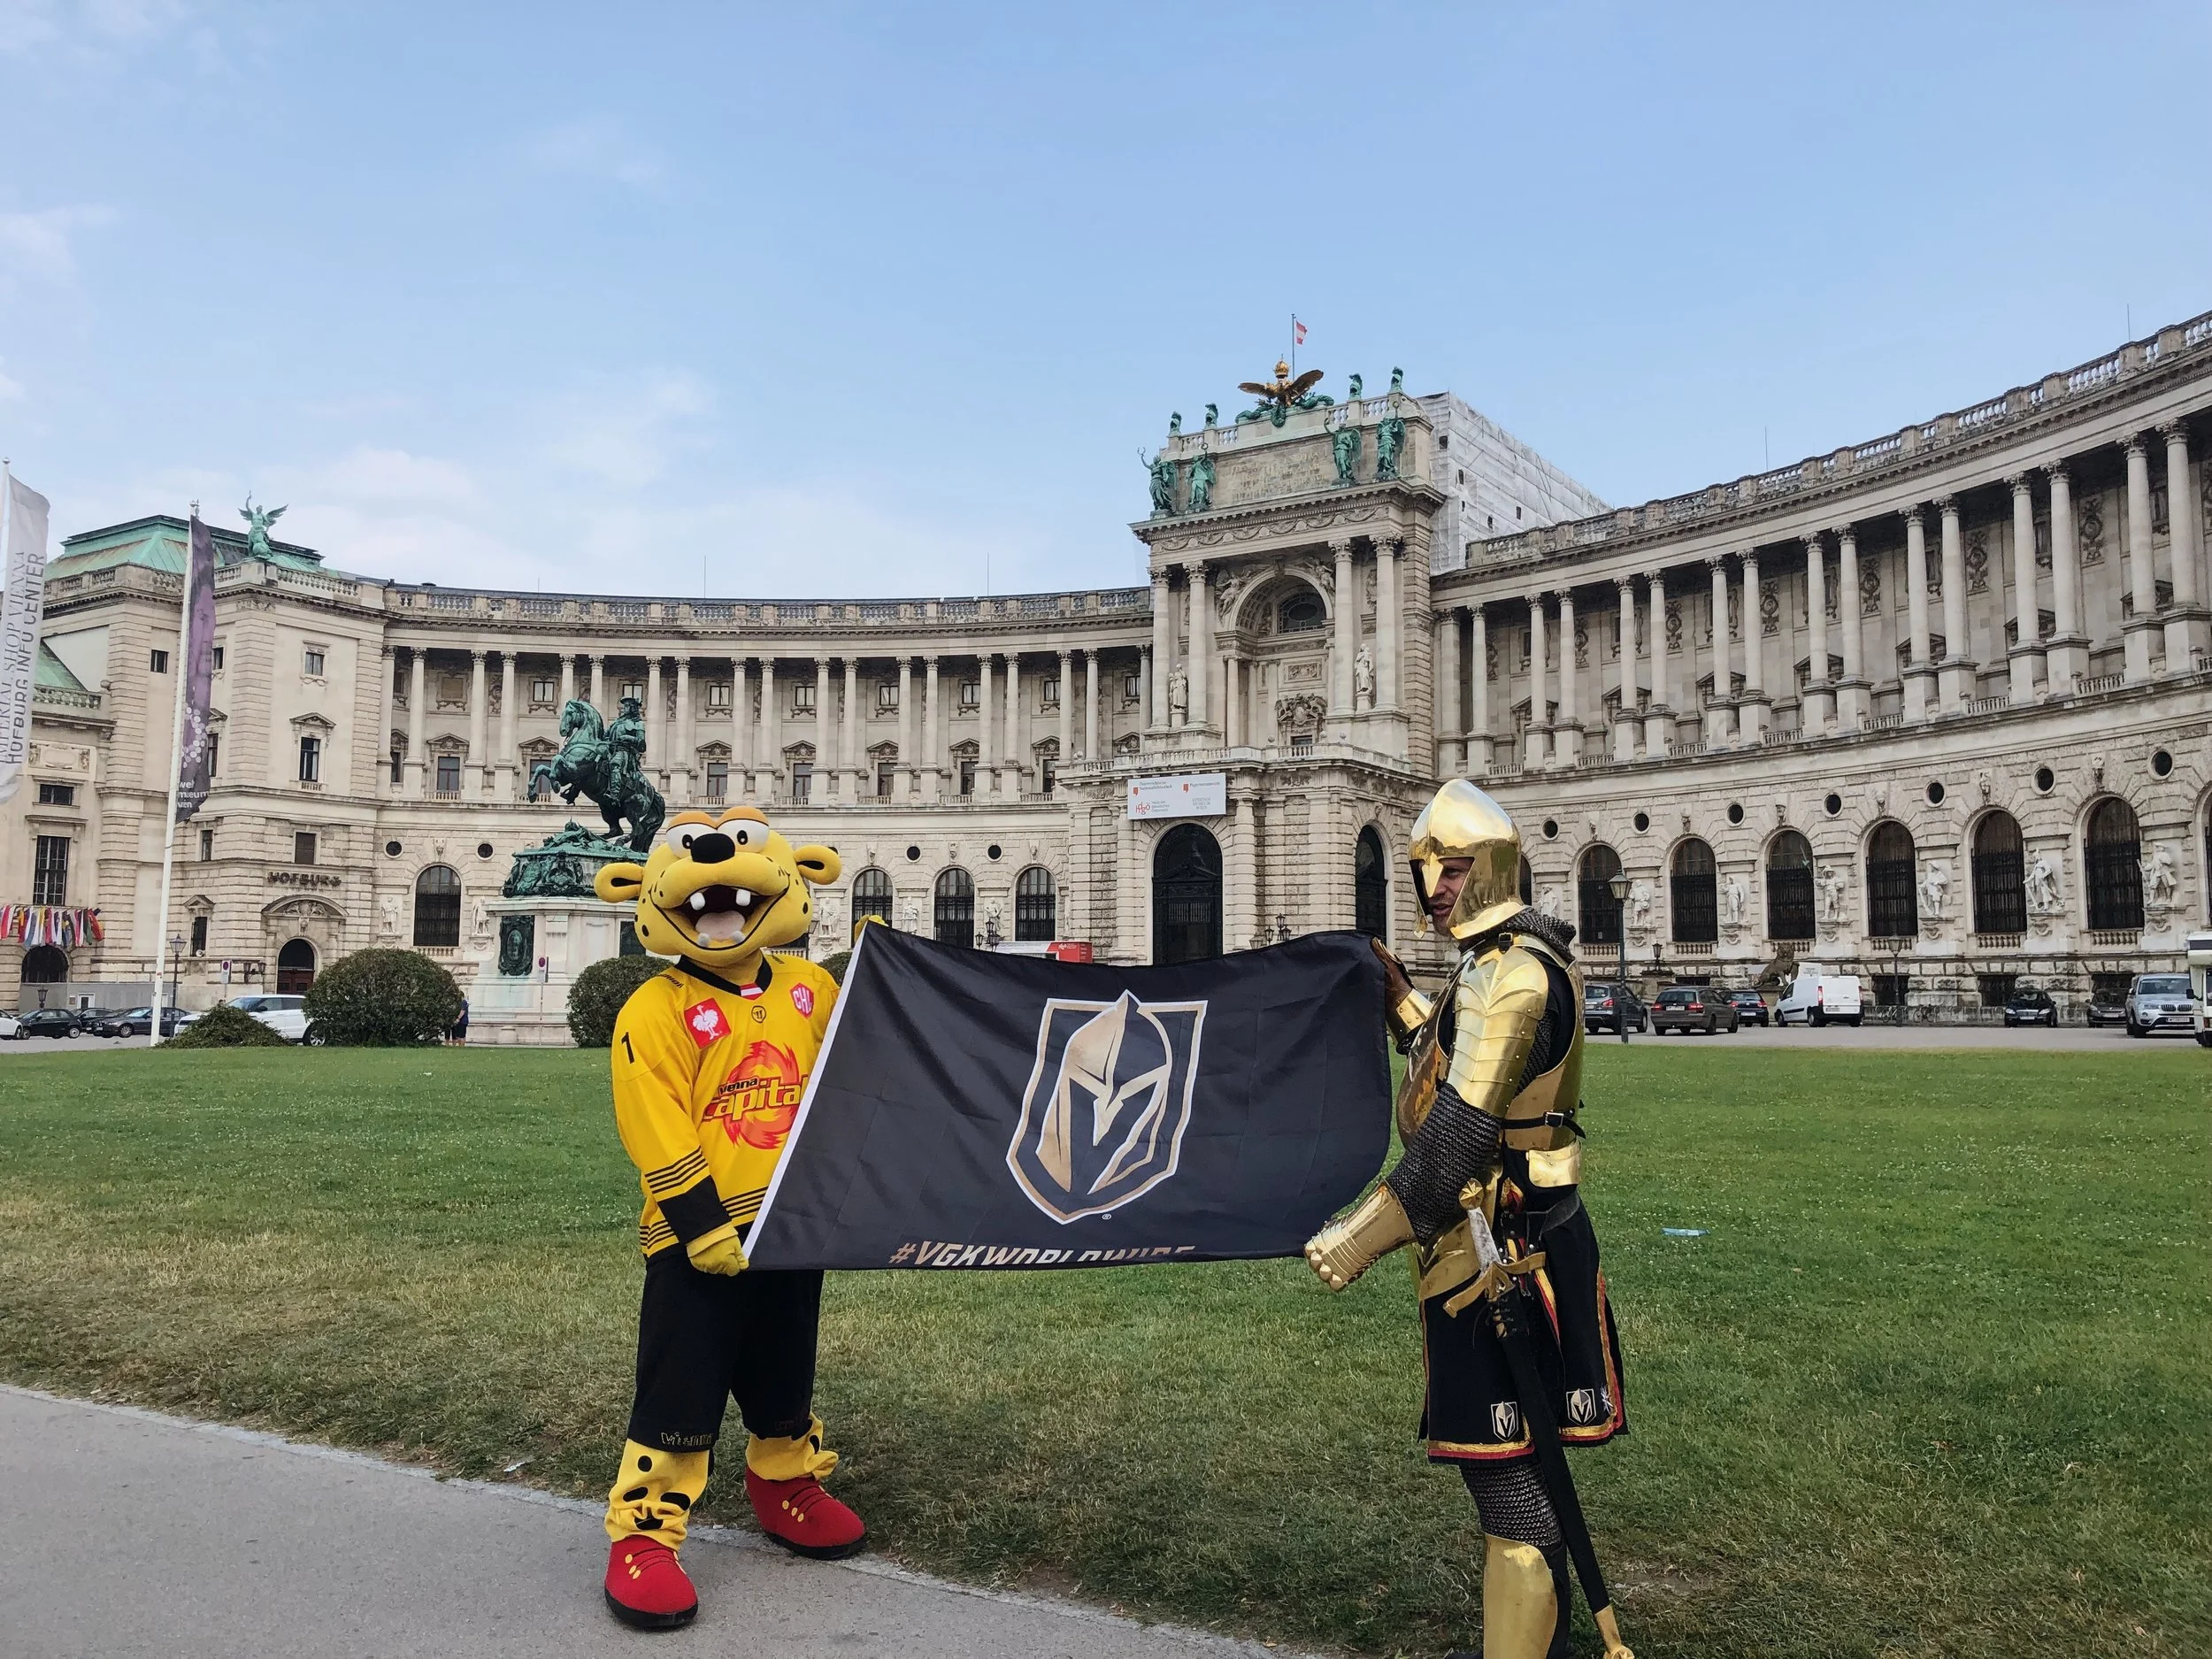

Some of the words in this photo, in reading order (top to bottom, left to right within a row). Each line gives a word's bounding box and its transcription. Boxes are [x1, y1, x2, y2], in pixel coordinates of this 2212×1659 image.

[8, 552, 25, 617] VIENNA
[23, 553, 45, 626] CENTER
[4, 623, 21, 674] SHOP
[16, 631, 34, 672] INFO
[5, 679, 28, 764] HOFBURG
[267, 872, 342, 887] HOFBURG
[793, 987, 812, 1015] CHL
[621, 1032, 635, 1064] 1
